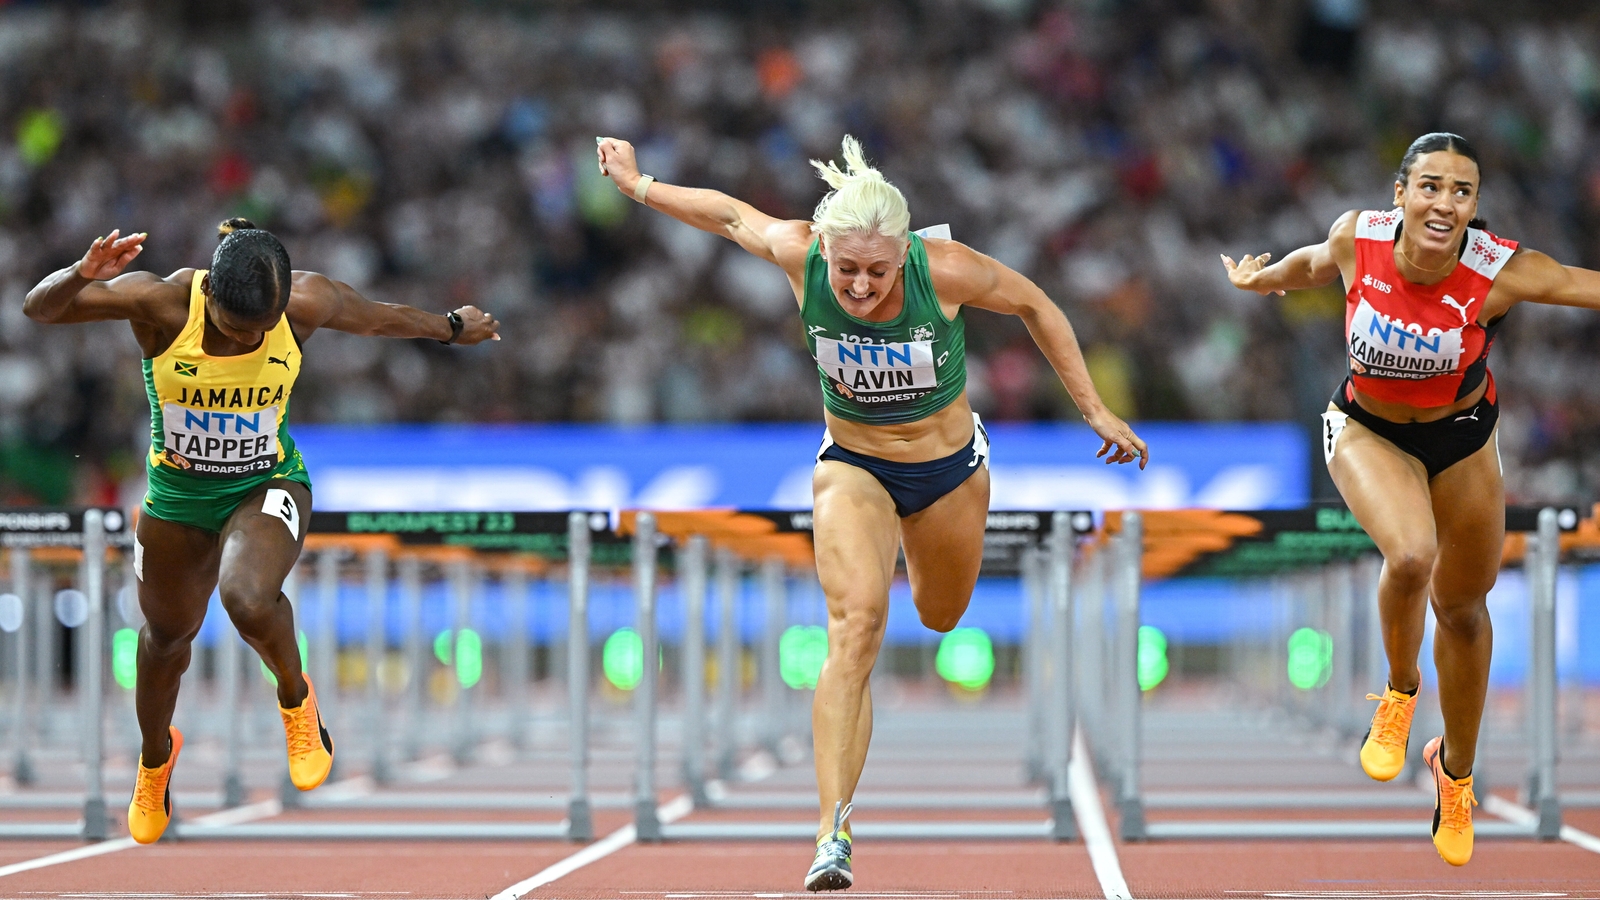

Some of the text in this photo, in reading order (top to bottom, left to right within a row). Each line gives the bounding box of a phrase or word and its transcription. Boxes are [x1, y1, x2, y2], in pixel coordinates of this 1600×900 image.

[1372, 278, 1392, 294] UBS
[1369, 313, 1441, 354] NTN
[837, 342, 912, 368] NTN
[1350, 332, 1453, 371] KAMBUNDJI
[838, 368, 914, 390] LAVIN
[1370, 368, 1434, 380] BUDAPEST
[176, 384, 284, 408] JAMAICA
[855, 392, 918, 403] BUDAPEST
[184, 409, 260, 436] NTN
[171, 431, 269, 459] TAPPER
[194, 460, 271, 474] BUDAPEST 23
[280, 495, 294, 522] 5
